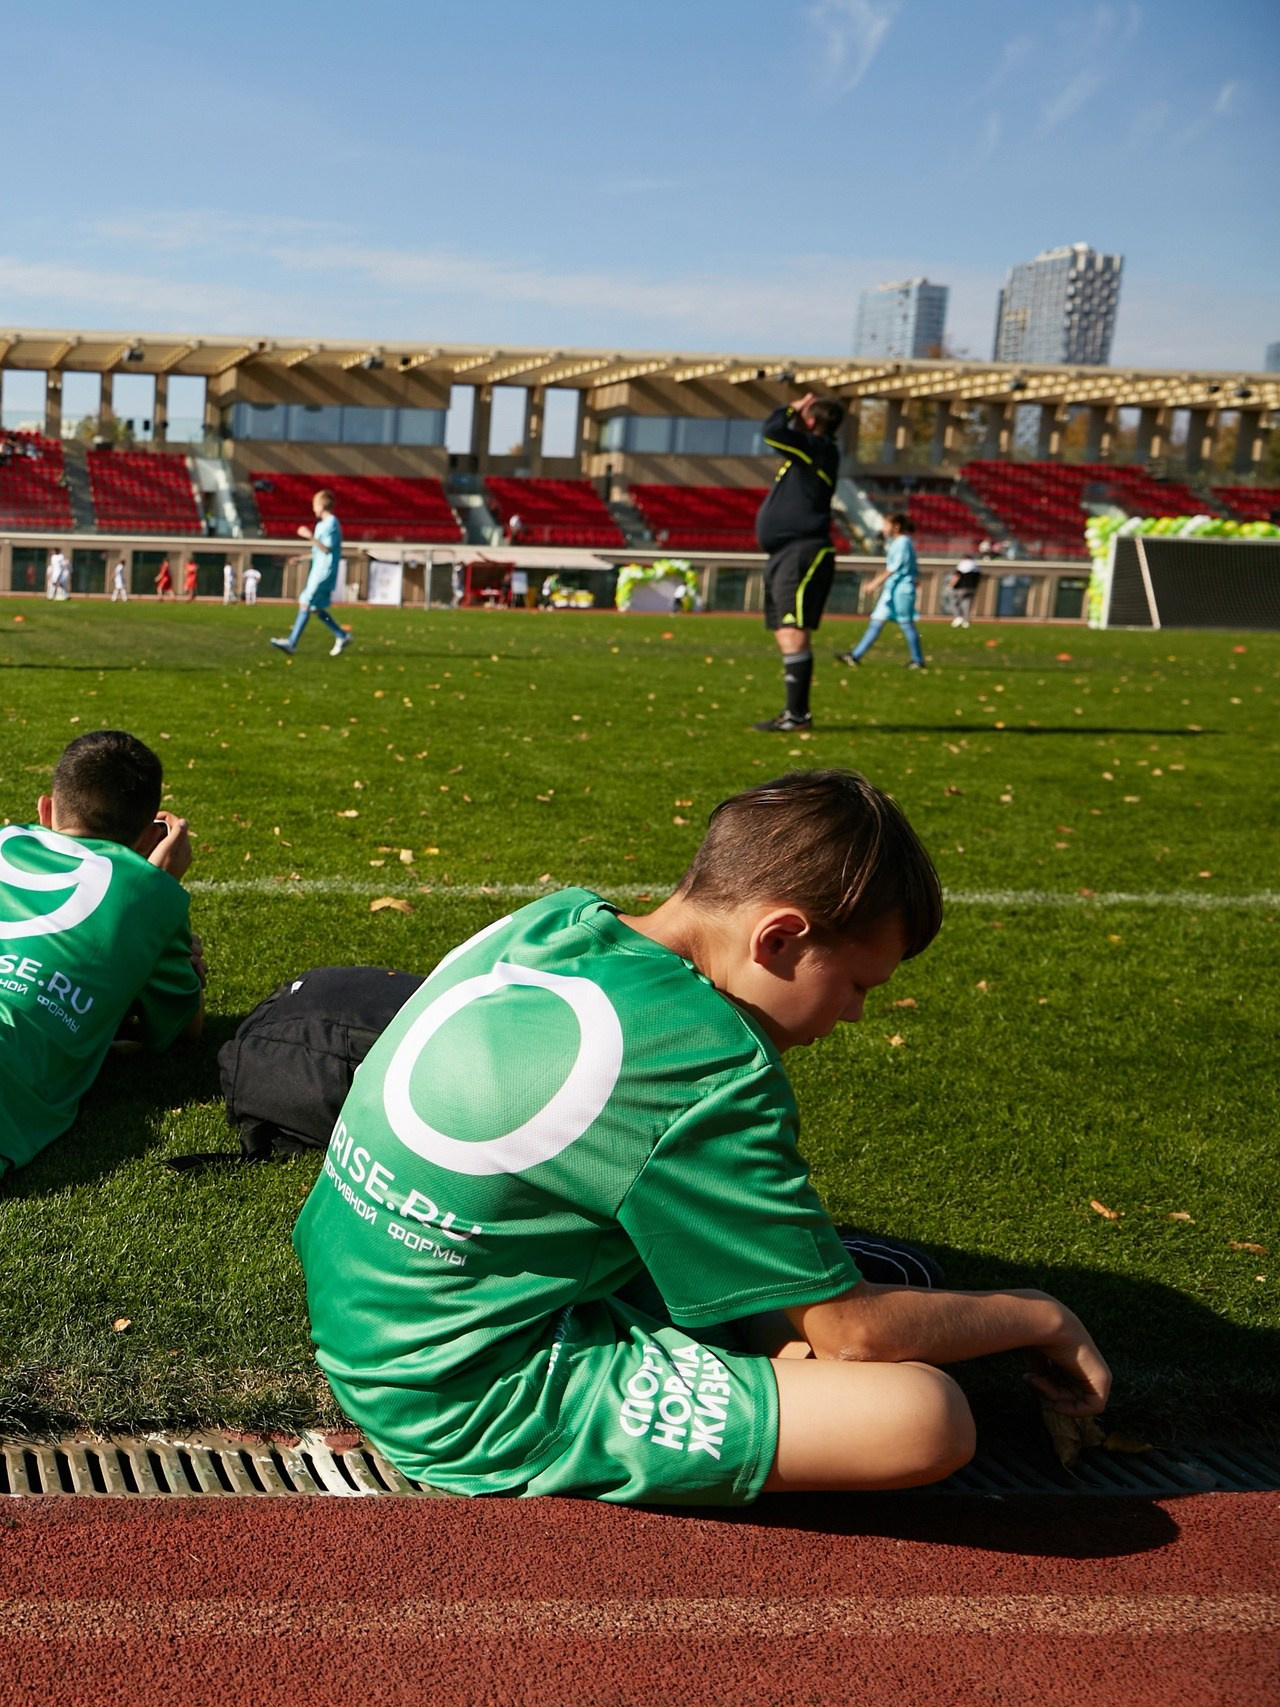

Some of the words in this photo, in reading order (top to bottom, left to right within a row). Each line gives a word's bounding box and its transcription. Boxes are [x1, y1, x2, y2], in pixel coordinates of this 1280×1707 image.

[37, 994, 81, 1034] ФОРМЫ
[387, 1221, 468, 1267] ФОРМЫ
[650, 1343, 700, 1451] НОРМА
